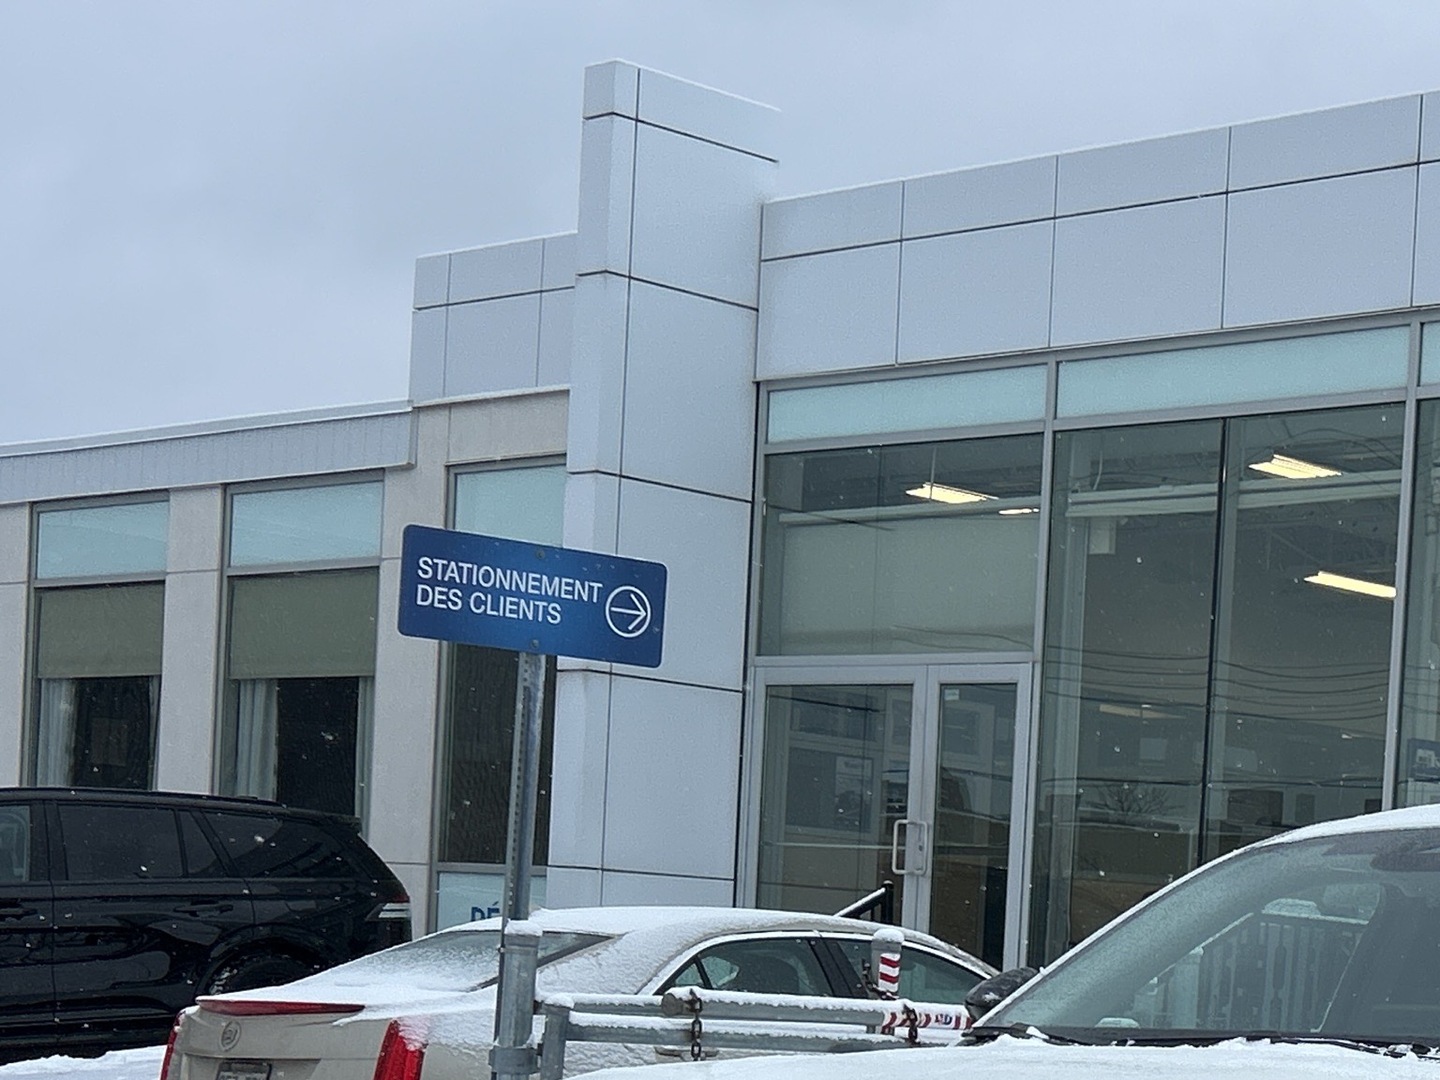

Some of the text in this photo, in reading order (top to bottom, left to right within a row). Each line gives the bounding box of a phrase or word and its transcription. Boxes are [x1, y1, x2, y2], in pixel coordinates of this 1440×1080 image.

[417, 556, 603, 604] STATIONNEMENT
[416, 584, 561, 625] DES CLIENTS
